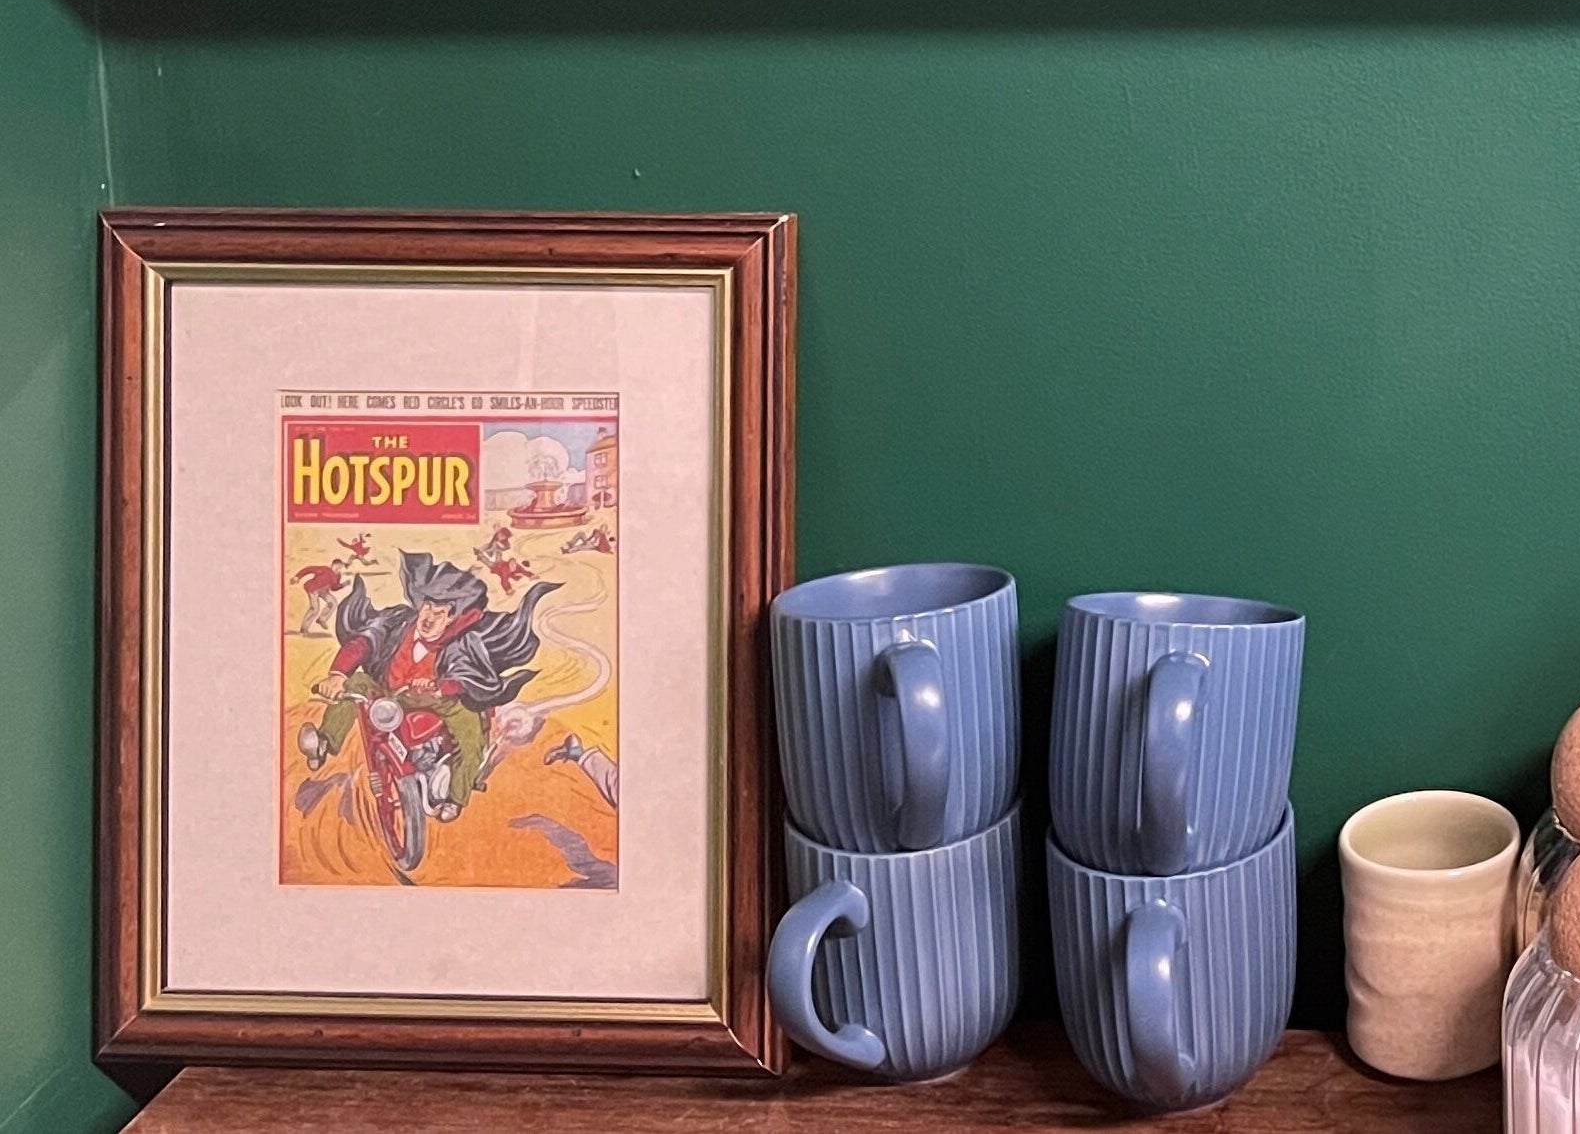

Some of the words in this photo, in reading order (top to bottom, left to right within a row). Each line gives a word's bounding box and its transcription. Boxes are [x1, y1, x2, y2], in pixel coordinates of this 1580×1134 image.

[281, 395, 302, 408] LOOK
[338, 395, 359, 408] HERE
[367, 395, 395, 409] COMES
[403, 396, 420, 409] RED
[428, 396, 464, 409] CIRCLE'S
[372, 435, 408, 449] THE
[293, 437, 471, 507] HOTSPUR
